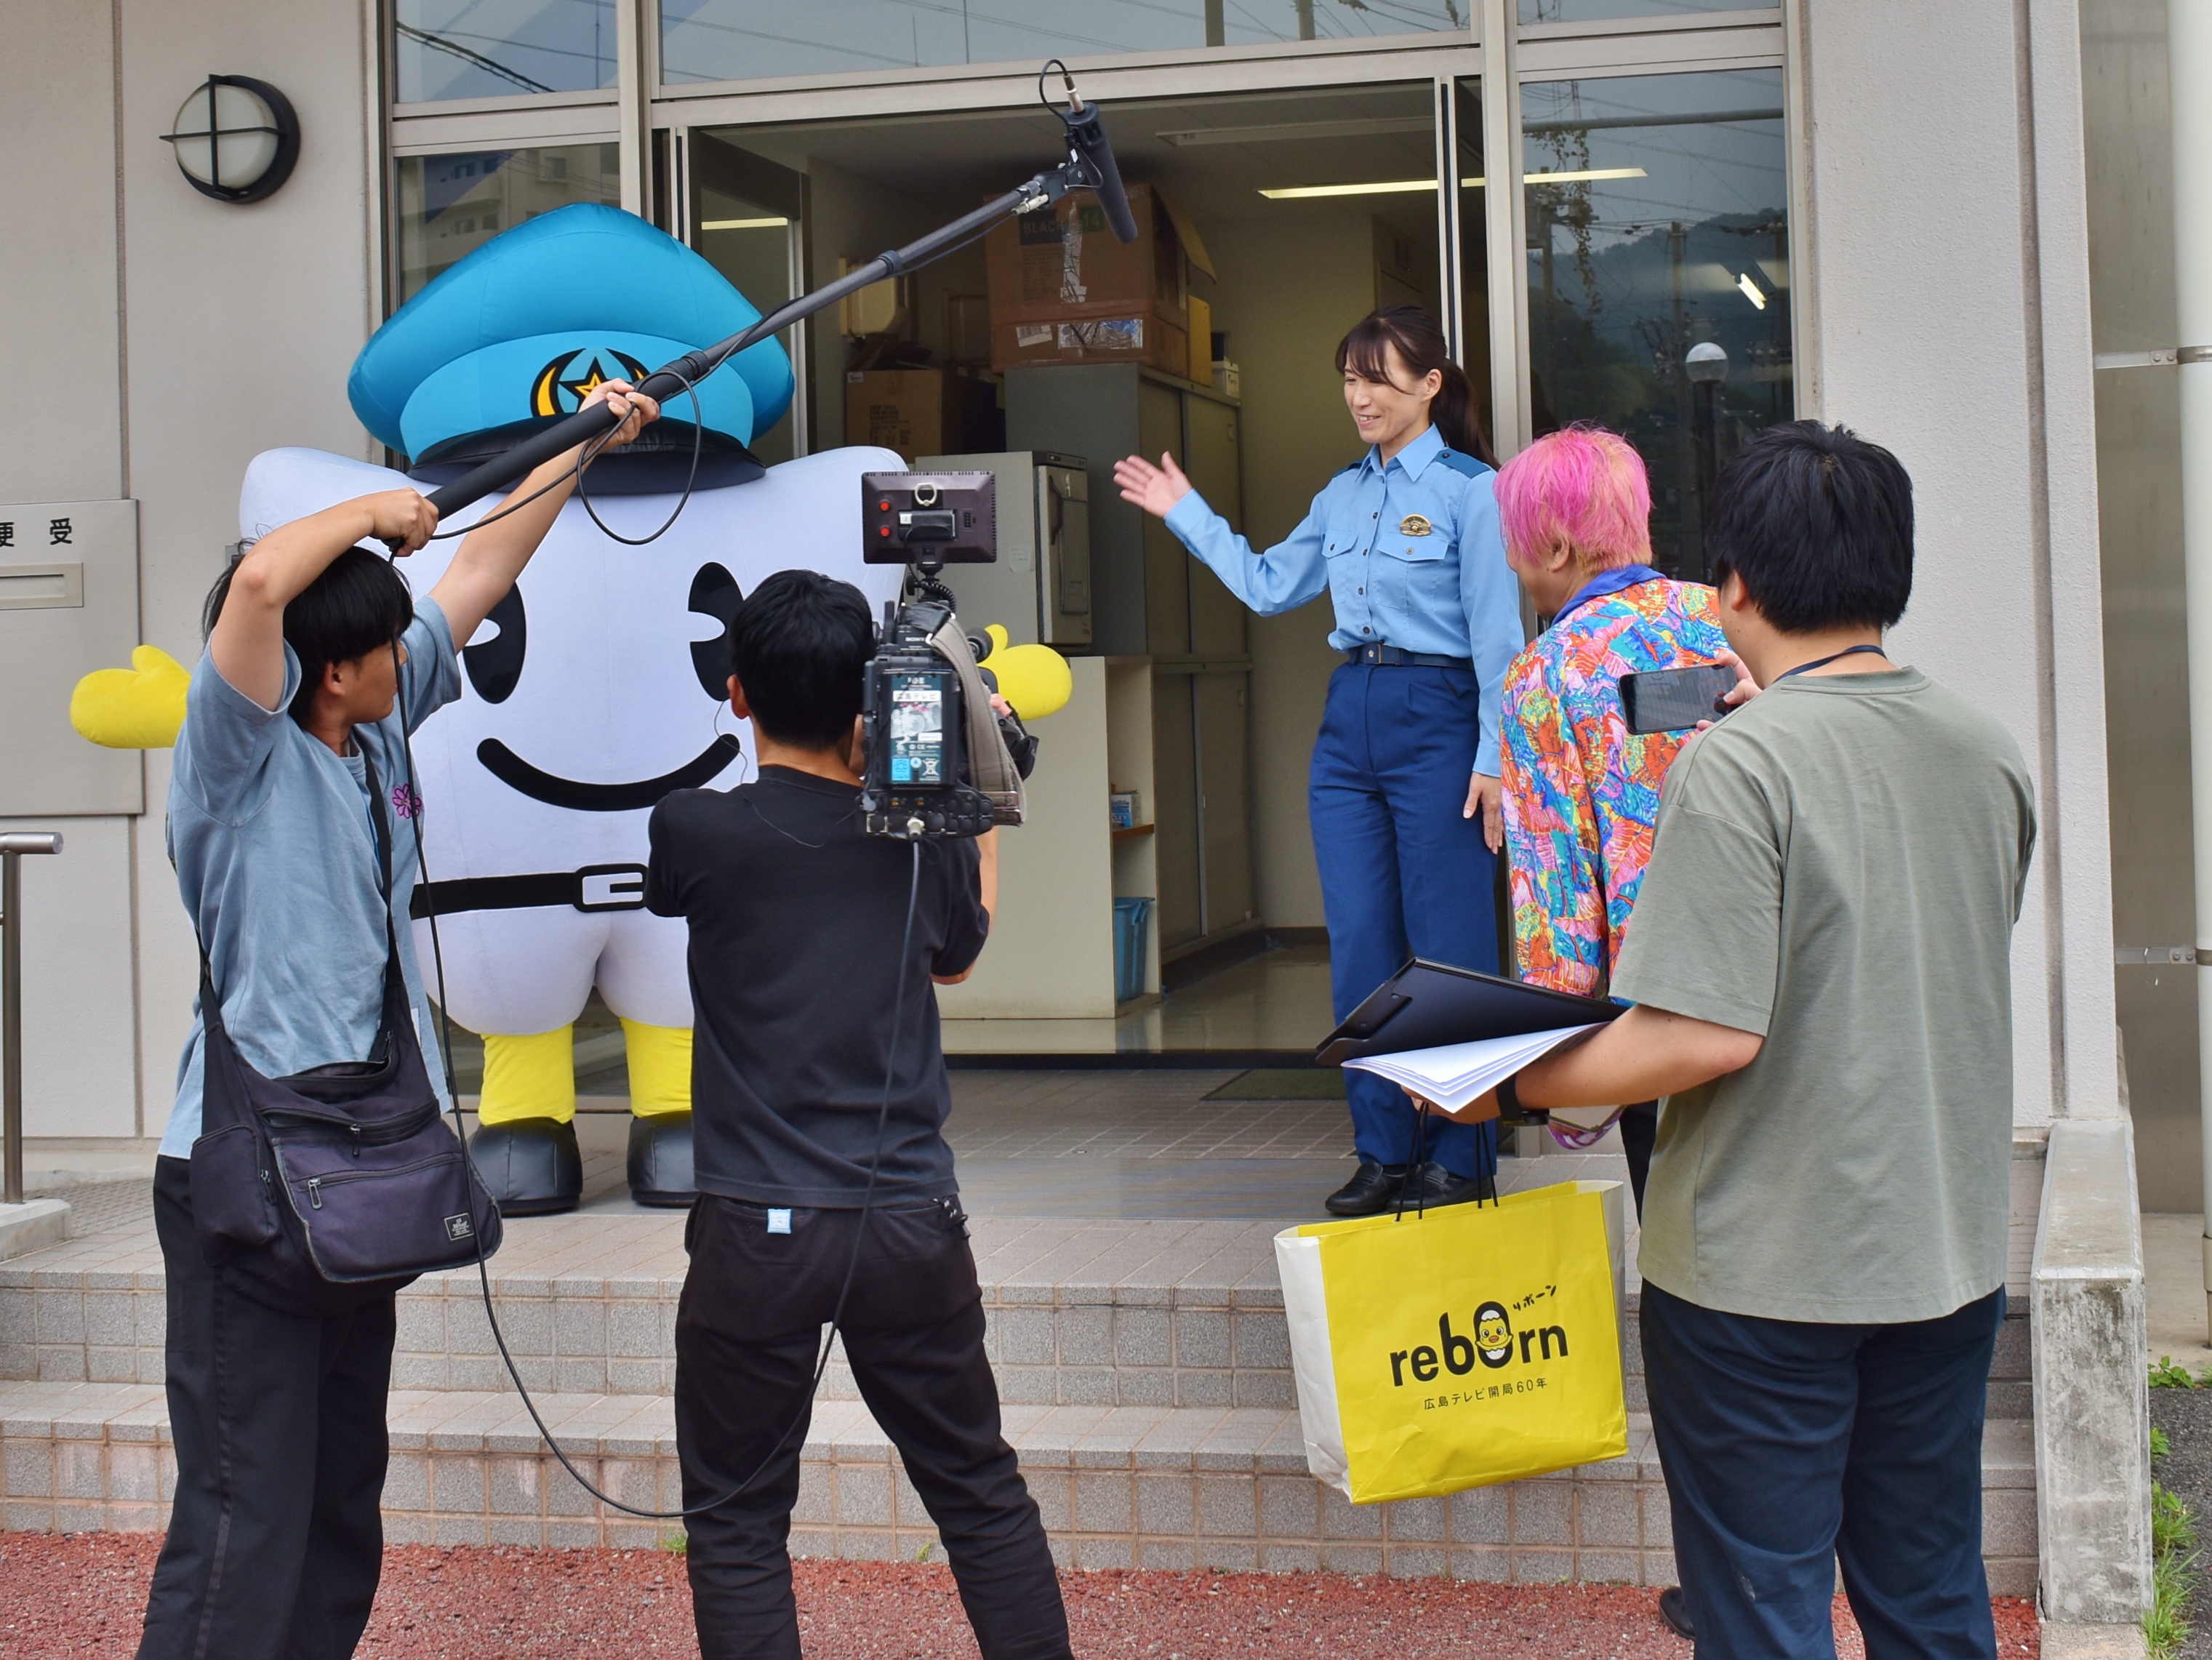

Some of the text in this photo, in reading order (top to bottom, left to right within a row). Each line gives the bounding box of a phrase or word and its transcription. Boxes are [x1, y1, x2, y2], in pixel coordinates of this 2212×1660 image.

[1512, 1285, 1557, 1311] リボーン
[1390, 1301, 1568, 1387] reborn
[1424, 1377, 1548, 1411] 広島テレビ開局60年
